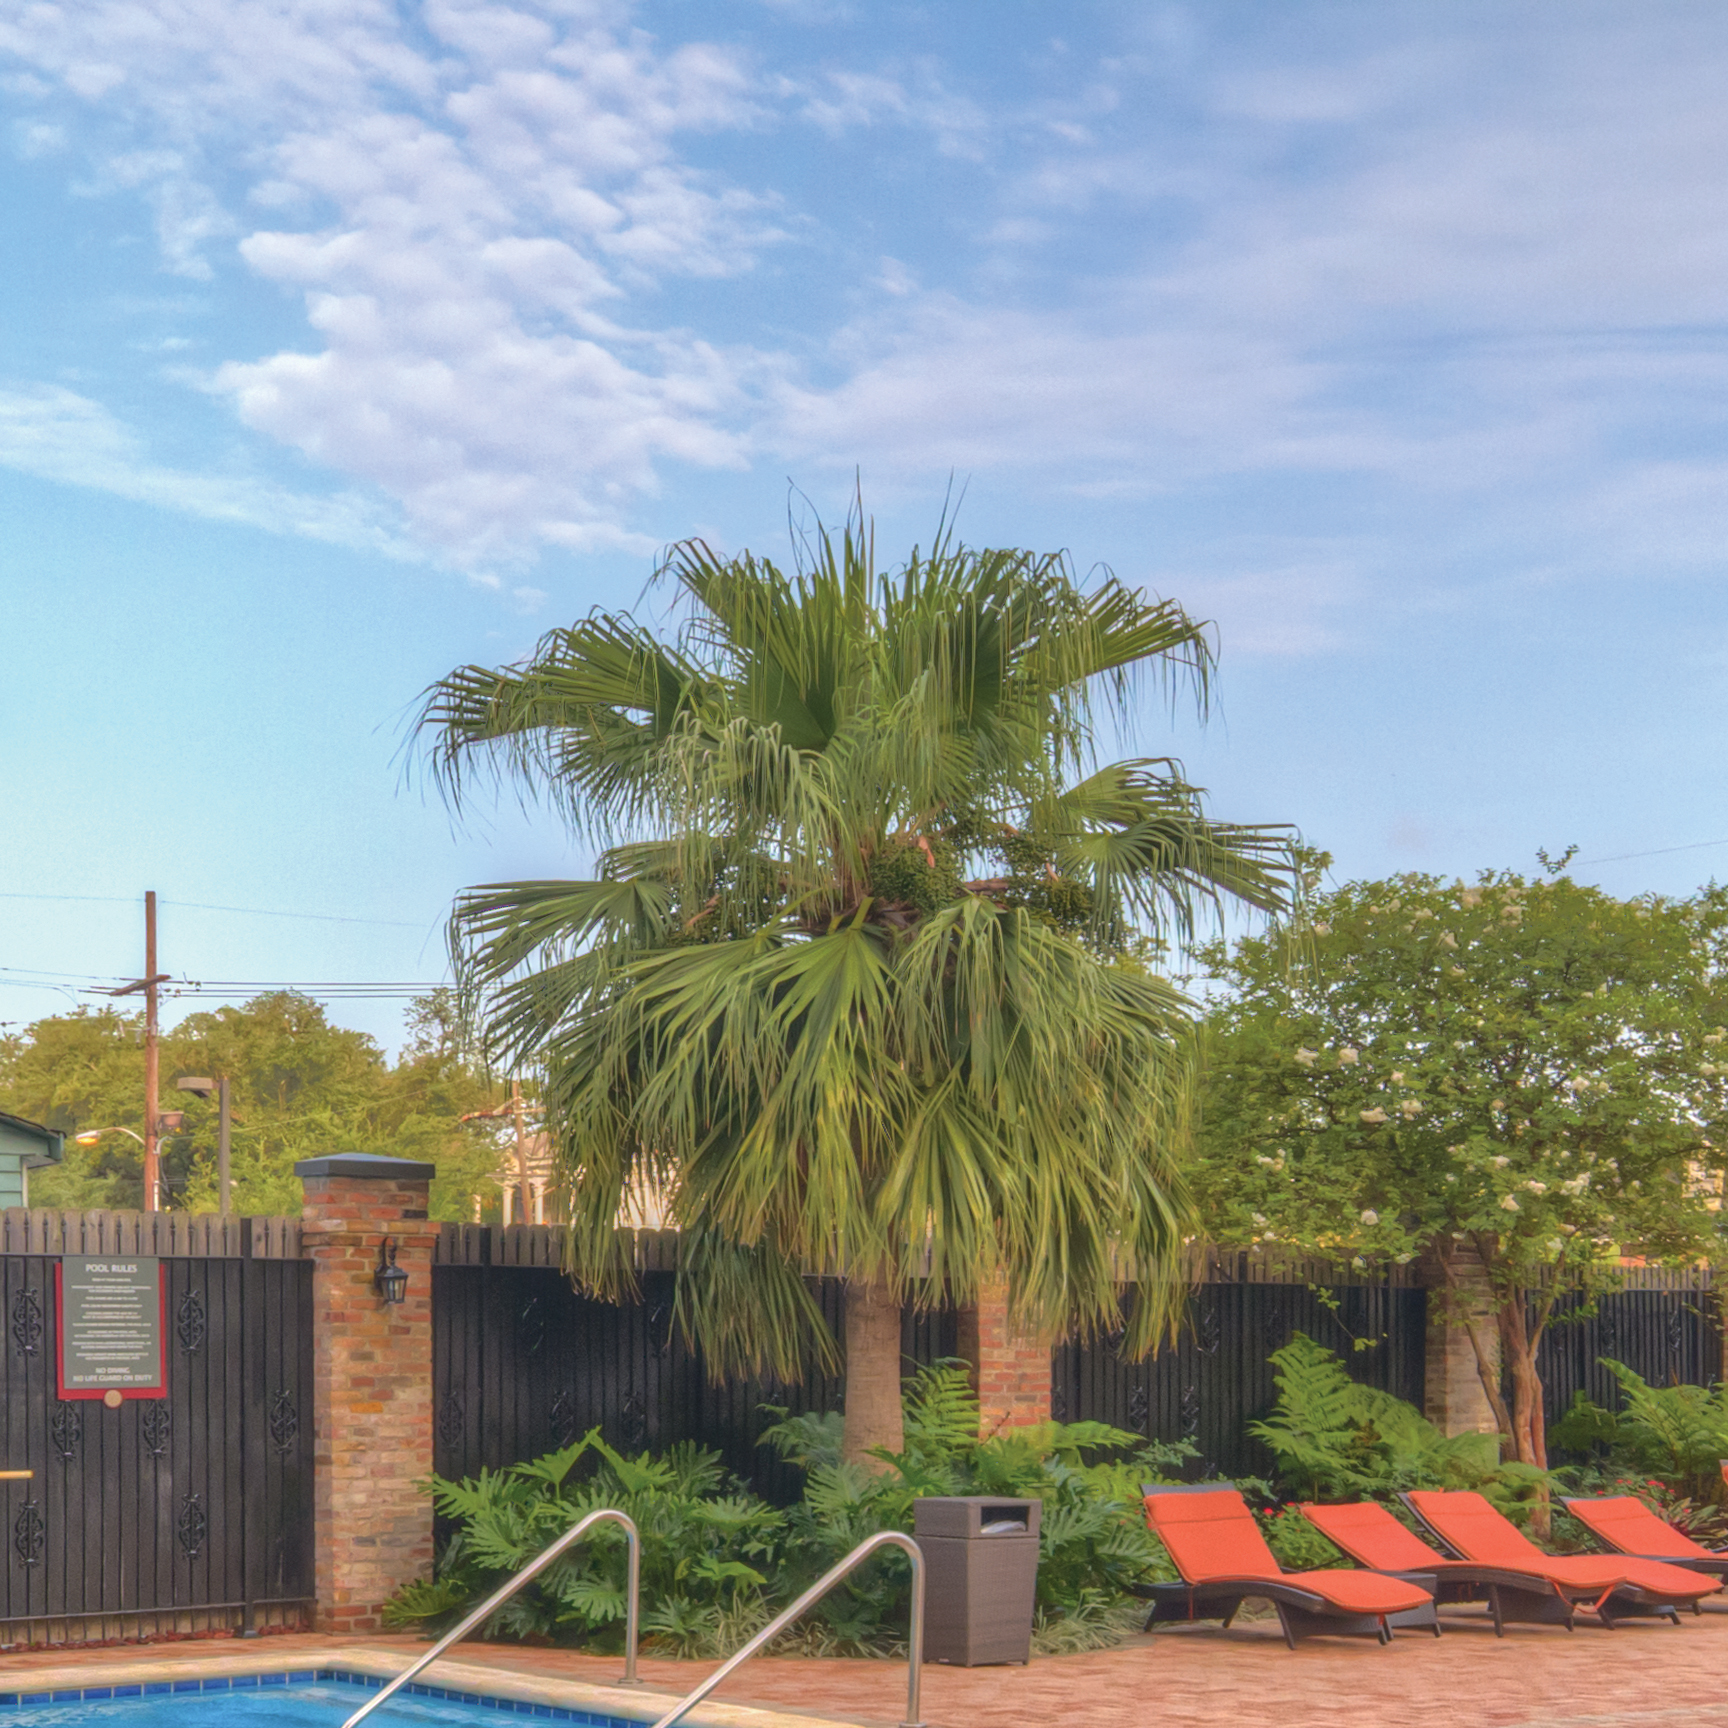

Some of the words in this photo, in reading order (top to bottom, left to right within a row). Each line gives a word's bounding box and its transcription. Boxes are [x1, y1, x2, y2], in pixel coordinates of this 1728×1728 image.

[85, 1264, 109, 1273] POOL
[111, 1264, 138, 1273] RULES
[123, 1374, 134, 1382] ON
[134, 1374, 153, 1382] DUTY
